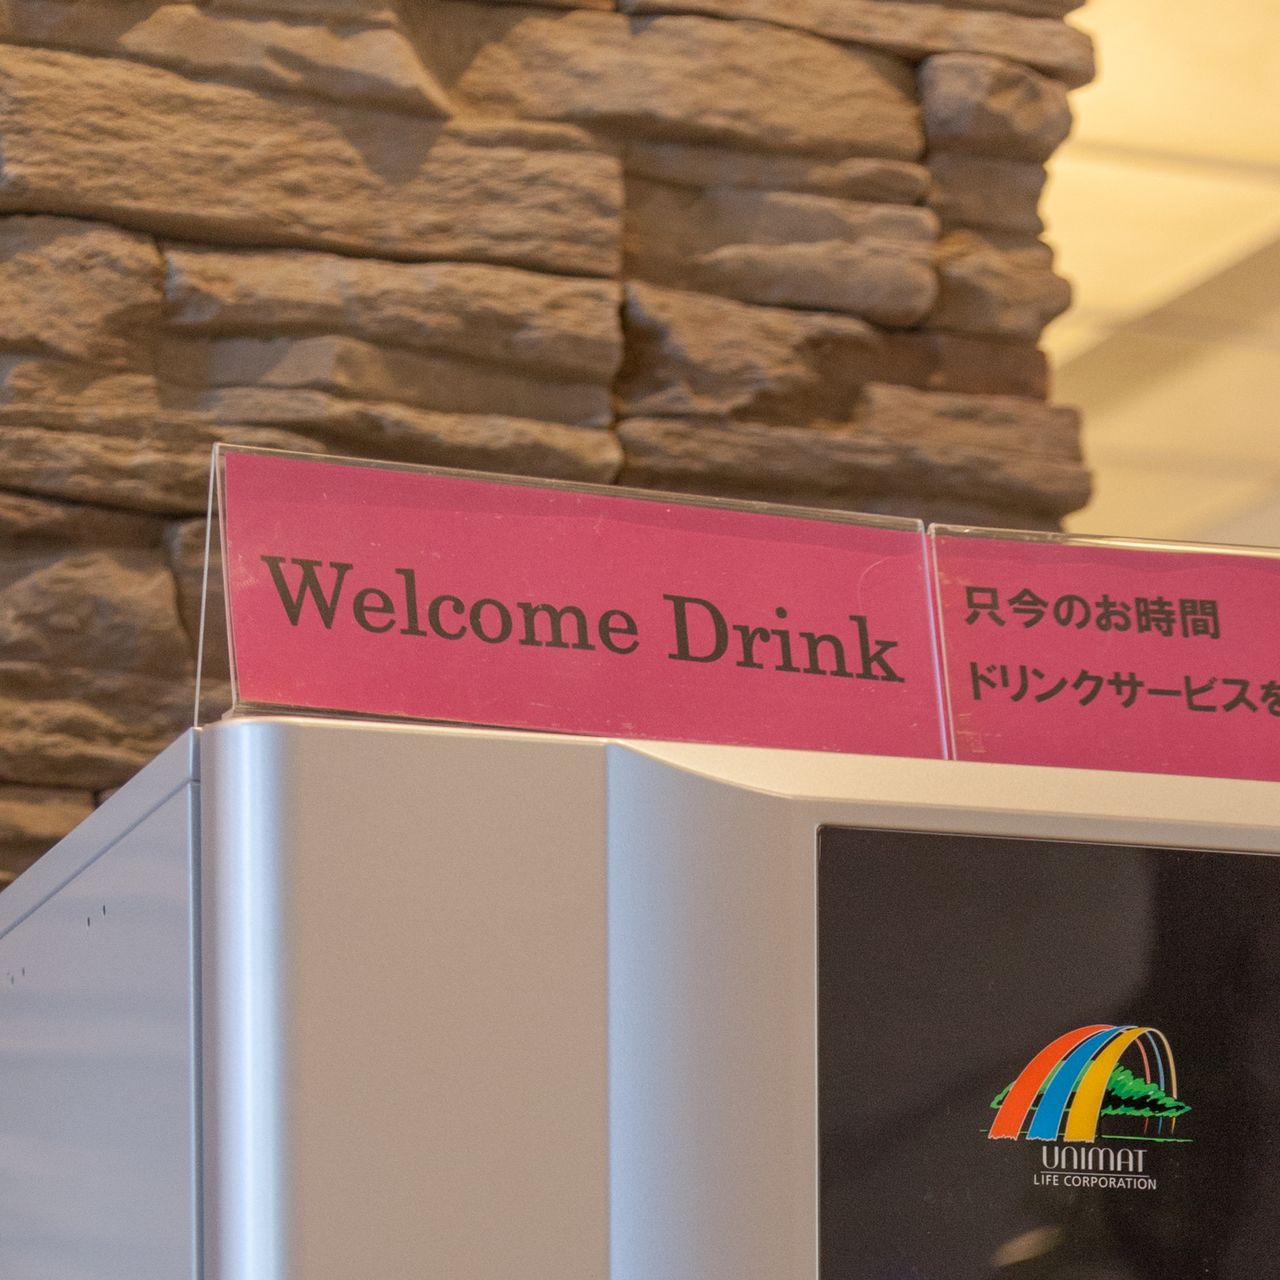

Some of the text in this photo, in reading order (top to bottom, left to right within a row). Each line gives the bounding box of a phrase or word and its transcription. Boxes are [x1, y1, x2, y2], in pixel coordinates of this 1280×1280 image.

[261, 555, 905, 683] Welcome Drink
[965, 585, 1221, 640] 只今のお時間
[1042, 1145, 1148, 1173] UNIMAT
[1033, 1174, 1157, 1190] LIFE CORPORATION
